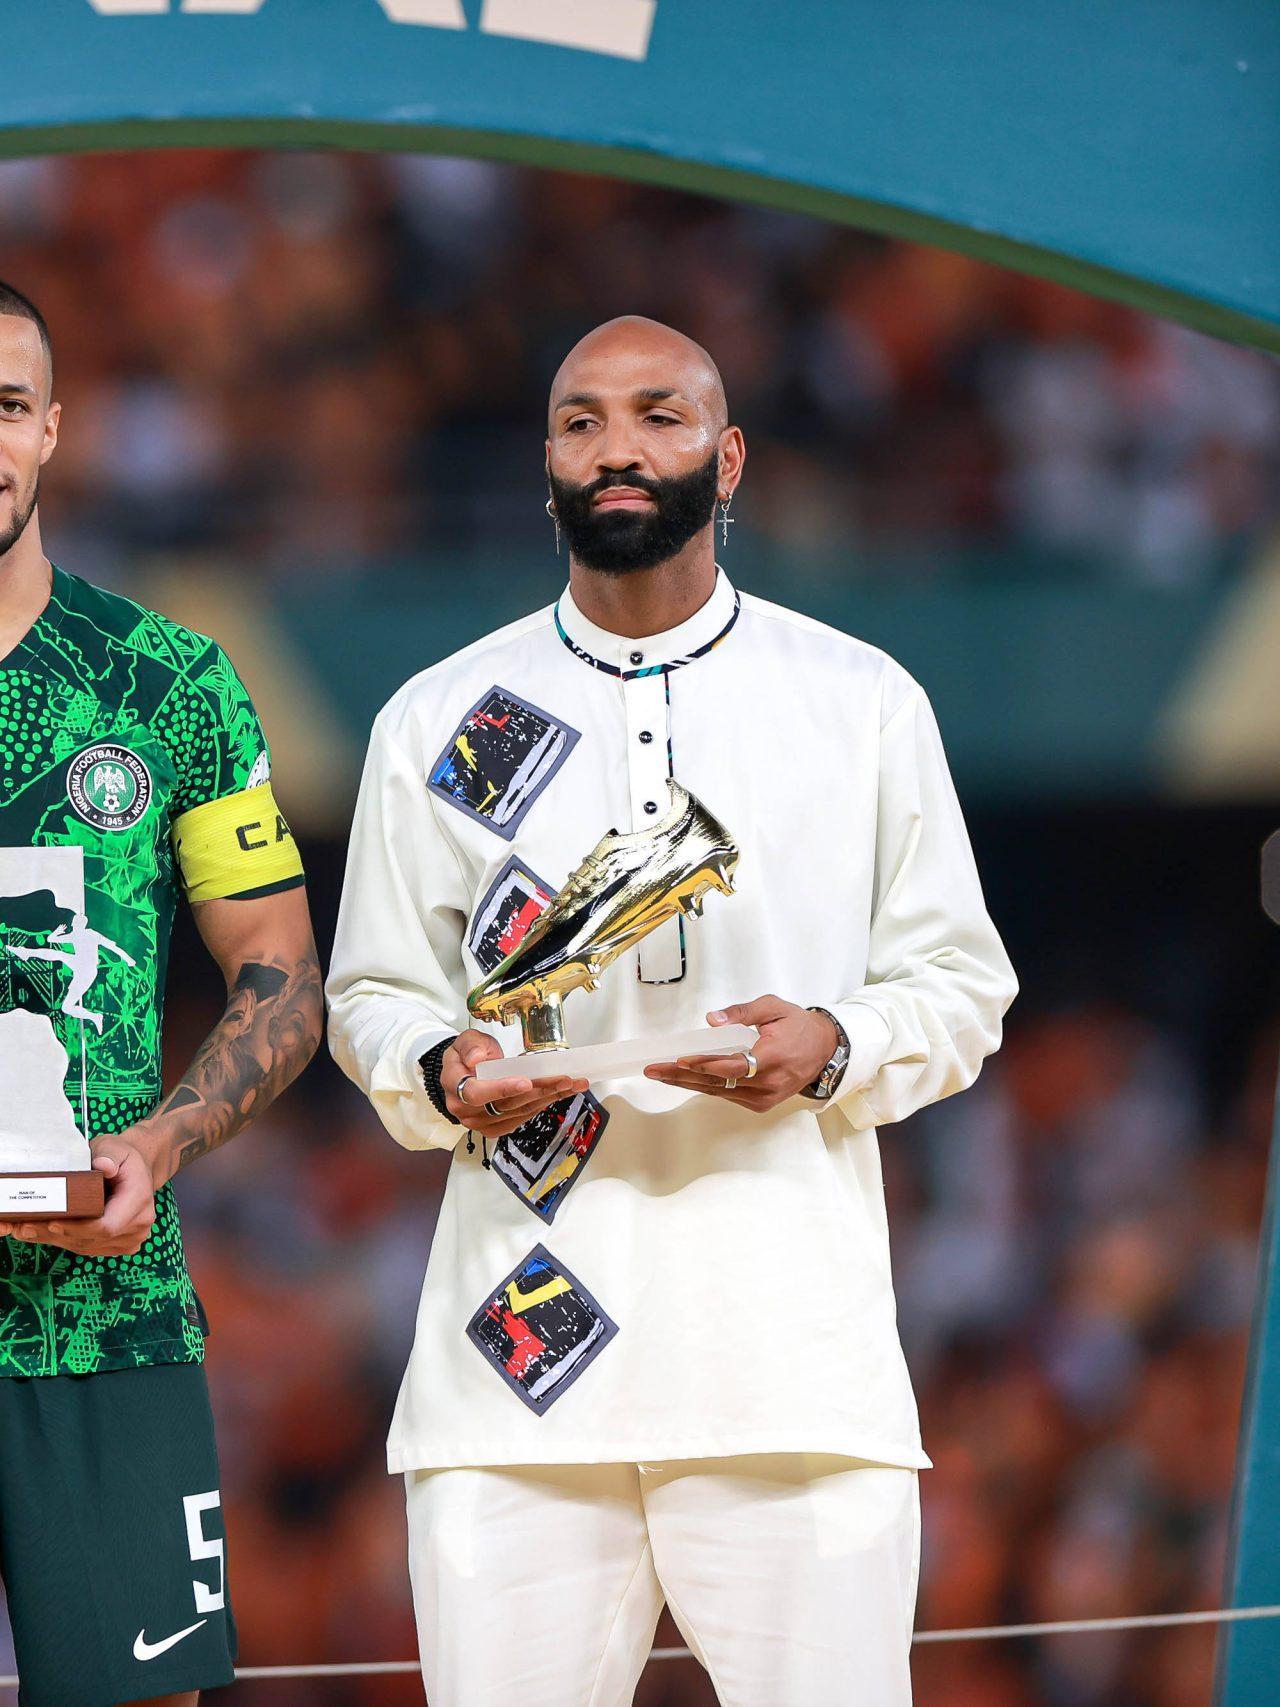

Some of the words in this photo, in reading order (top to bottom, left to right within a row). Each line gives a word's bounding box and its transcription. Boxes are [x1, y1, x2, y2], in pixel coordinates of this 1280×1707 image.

[75, 749, 123, 774] FOOTBALL
[71, 774, 91, 814] NIGERIA
[124, 755, 148, 817] FEDERATION
[102, 816, 123, 826] 1945
[182, 1489, 225, 1613] 5
